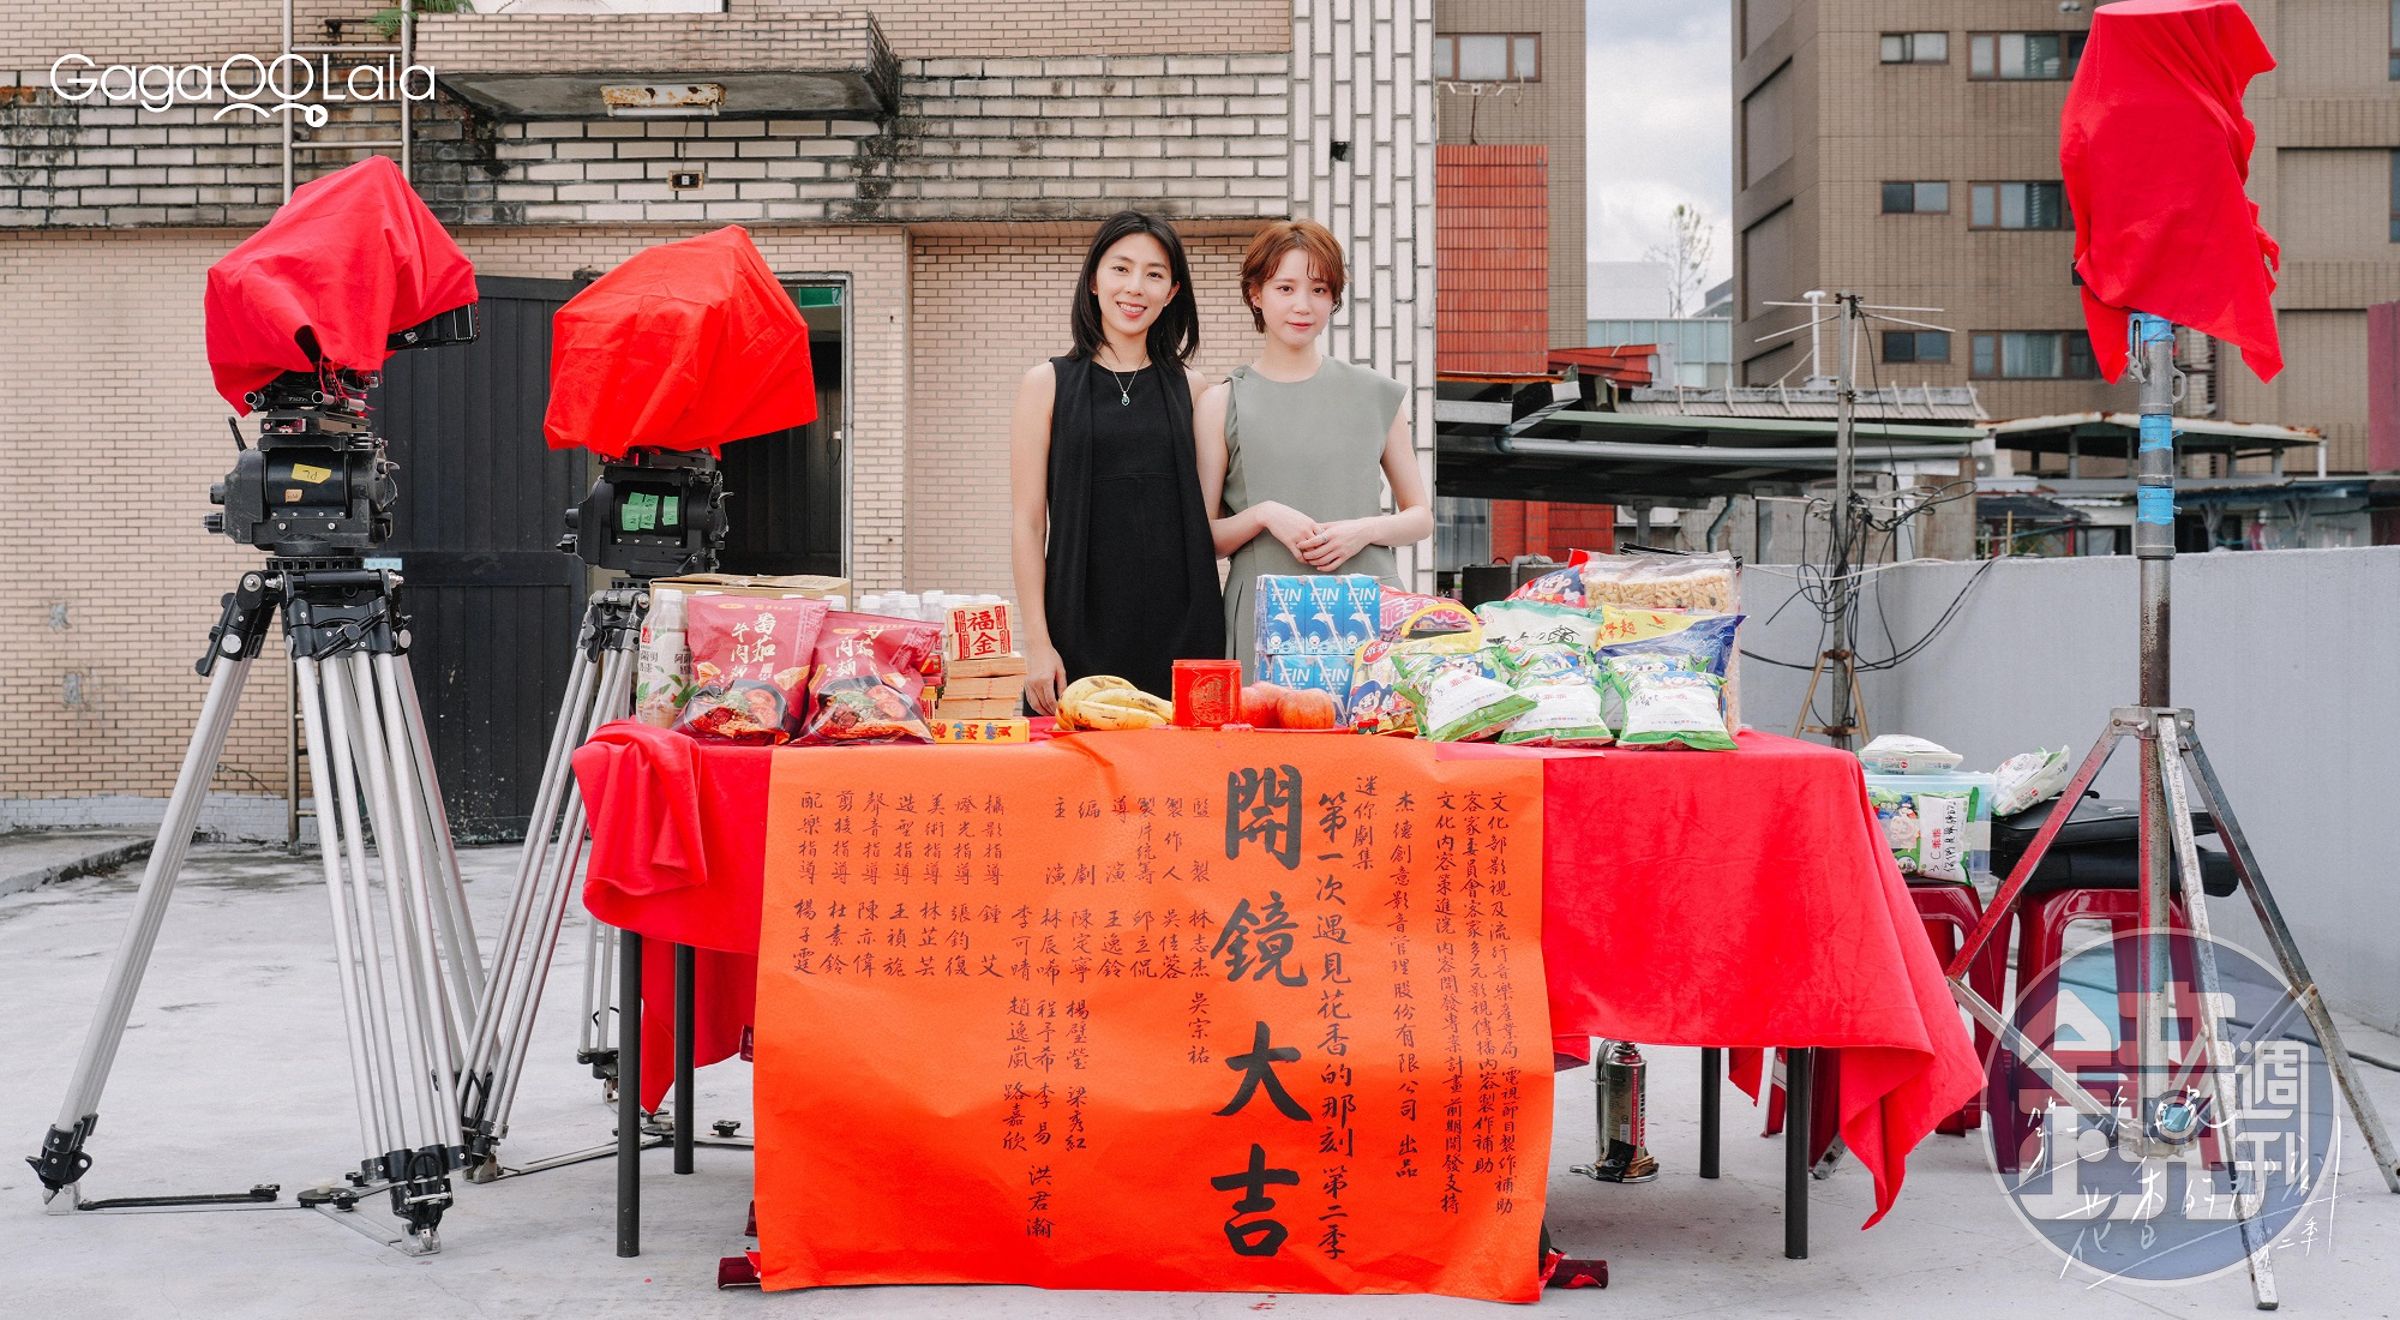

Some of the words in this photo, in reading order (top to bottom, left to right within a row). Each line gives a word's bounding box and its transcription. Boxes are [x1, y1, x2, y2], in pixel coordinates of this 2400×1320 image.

[966, 610, 999, 656] 福金
[797, 791, 823, 885] 配樂指導
[831, 790, 854, 885] 剪接指導
[861, 791, 889, 885] 聲音指導
[893, 793, 918, 885] 造型指導
[923, 793, 945, 885] 美術指導
[953, 795, 977, 885] 燈光指導
[981, 794, 1004, 886] 攝影指導
[1352, 775, 1378, 870] 迷你劇集
[1158, 908, 1186, 979] 吳佳蓉
[1210, 764, 1314, 1257] 開鏡大吉
[1002, 1081, 1032, 1151] 路嘉欣
[1396, 1134, 1418, 1178] 出品
